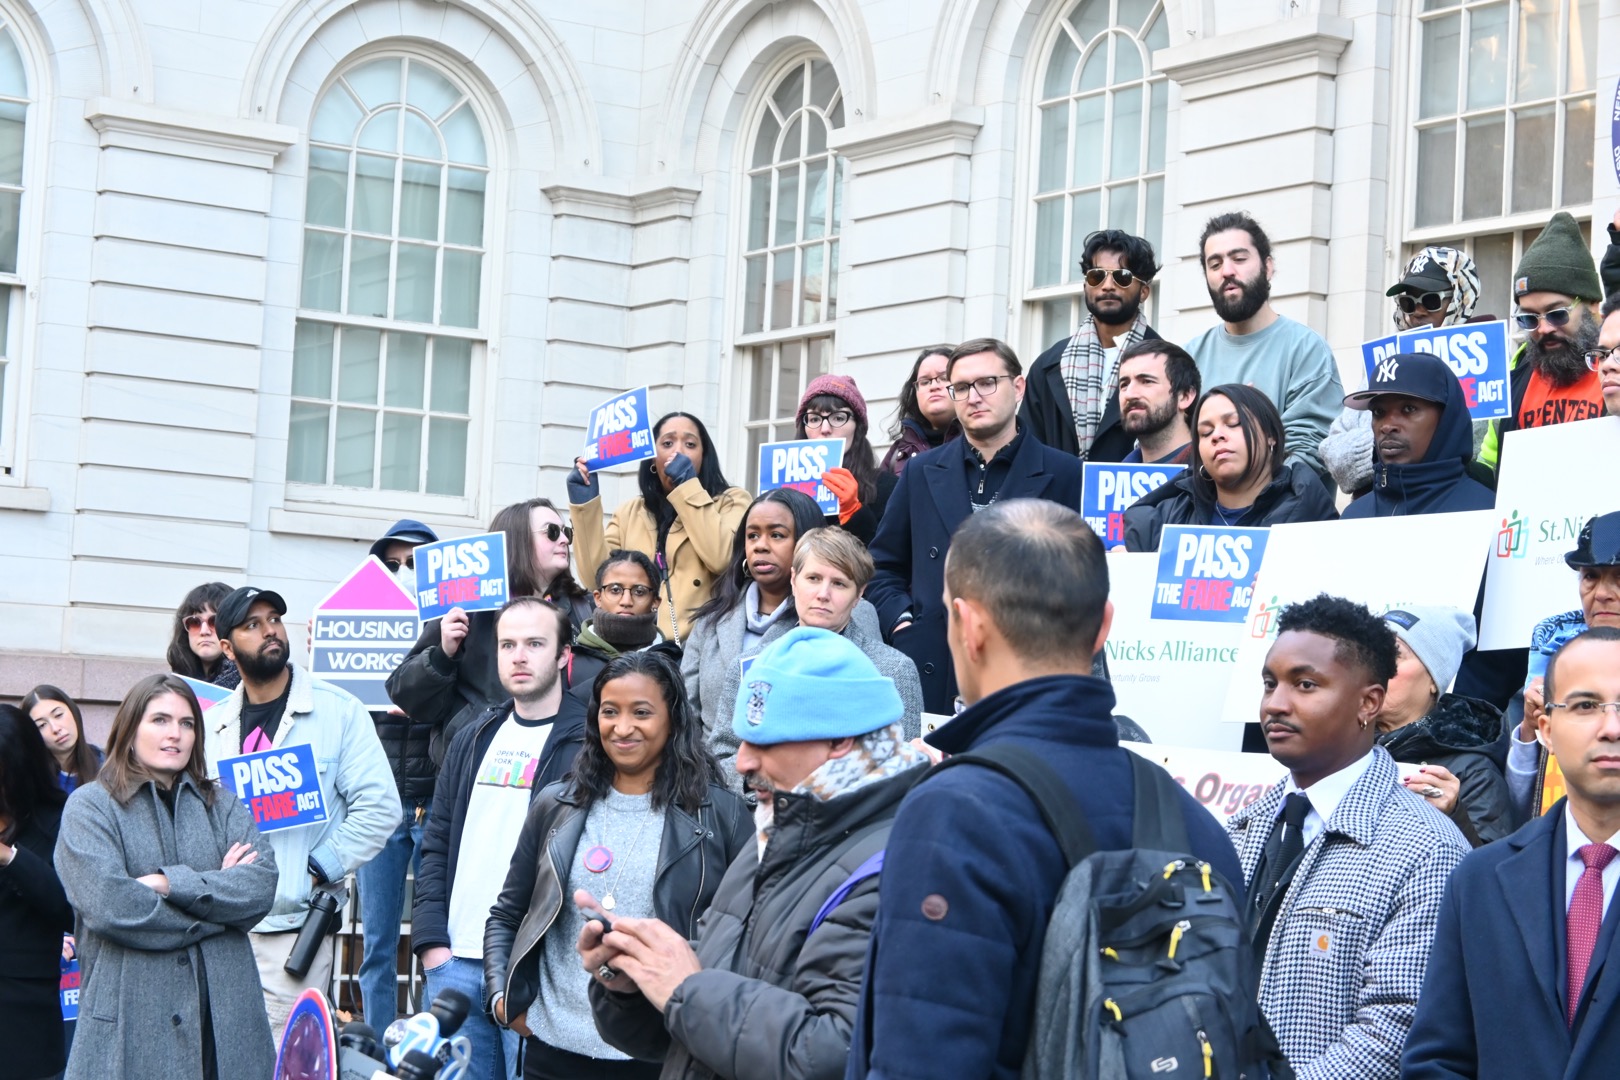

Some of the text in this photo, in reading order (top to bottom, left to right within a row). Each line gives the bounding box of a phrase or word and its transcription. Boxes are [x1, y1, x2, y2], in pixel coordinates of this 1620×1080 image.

[1478, 379, 1504, 403] ACT
[592, 395, 638, 440] PASS
[598, 429, 634, 460] FARE
[631, 428, 650, 449] ACT
[771, 444, 828, 484] PASS
[1084, 516, 1106, 537] THE
[427, 540, 490, 584] PASS
[1174, 533, 1253, 580] PASS
[418, 576, 504, 609] THE FARE ACT
[1156, 578, 1253, 612] THE FARE AC
[316, 620, 414, 639] HOUSING
[327, 651, 404, 671] WORKS
[1105, 639, 1240, 663] Nicks Alliance
[493, 757, 513, 765] YORK
[496, 749, 532, 759] OPEN NEW
[231, 752, 303, 800] PASS
[250, 790, 320, 823] FARE ACT
